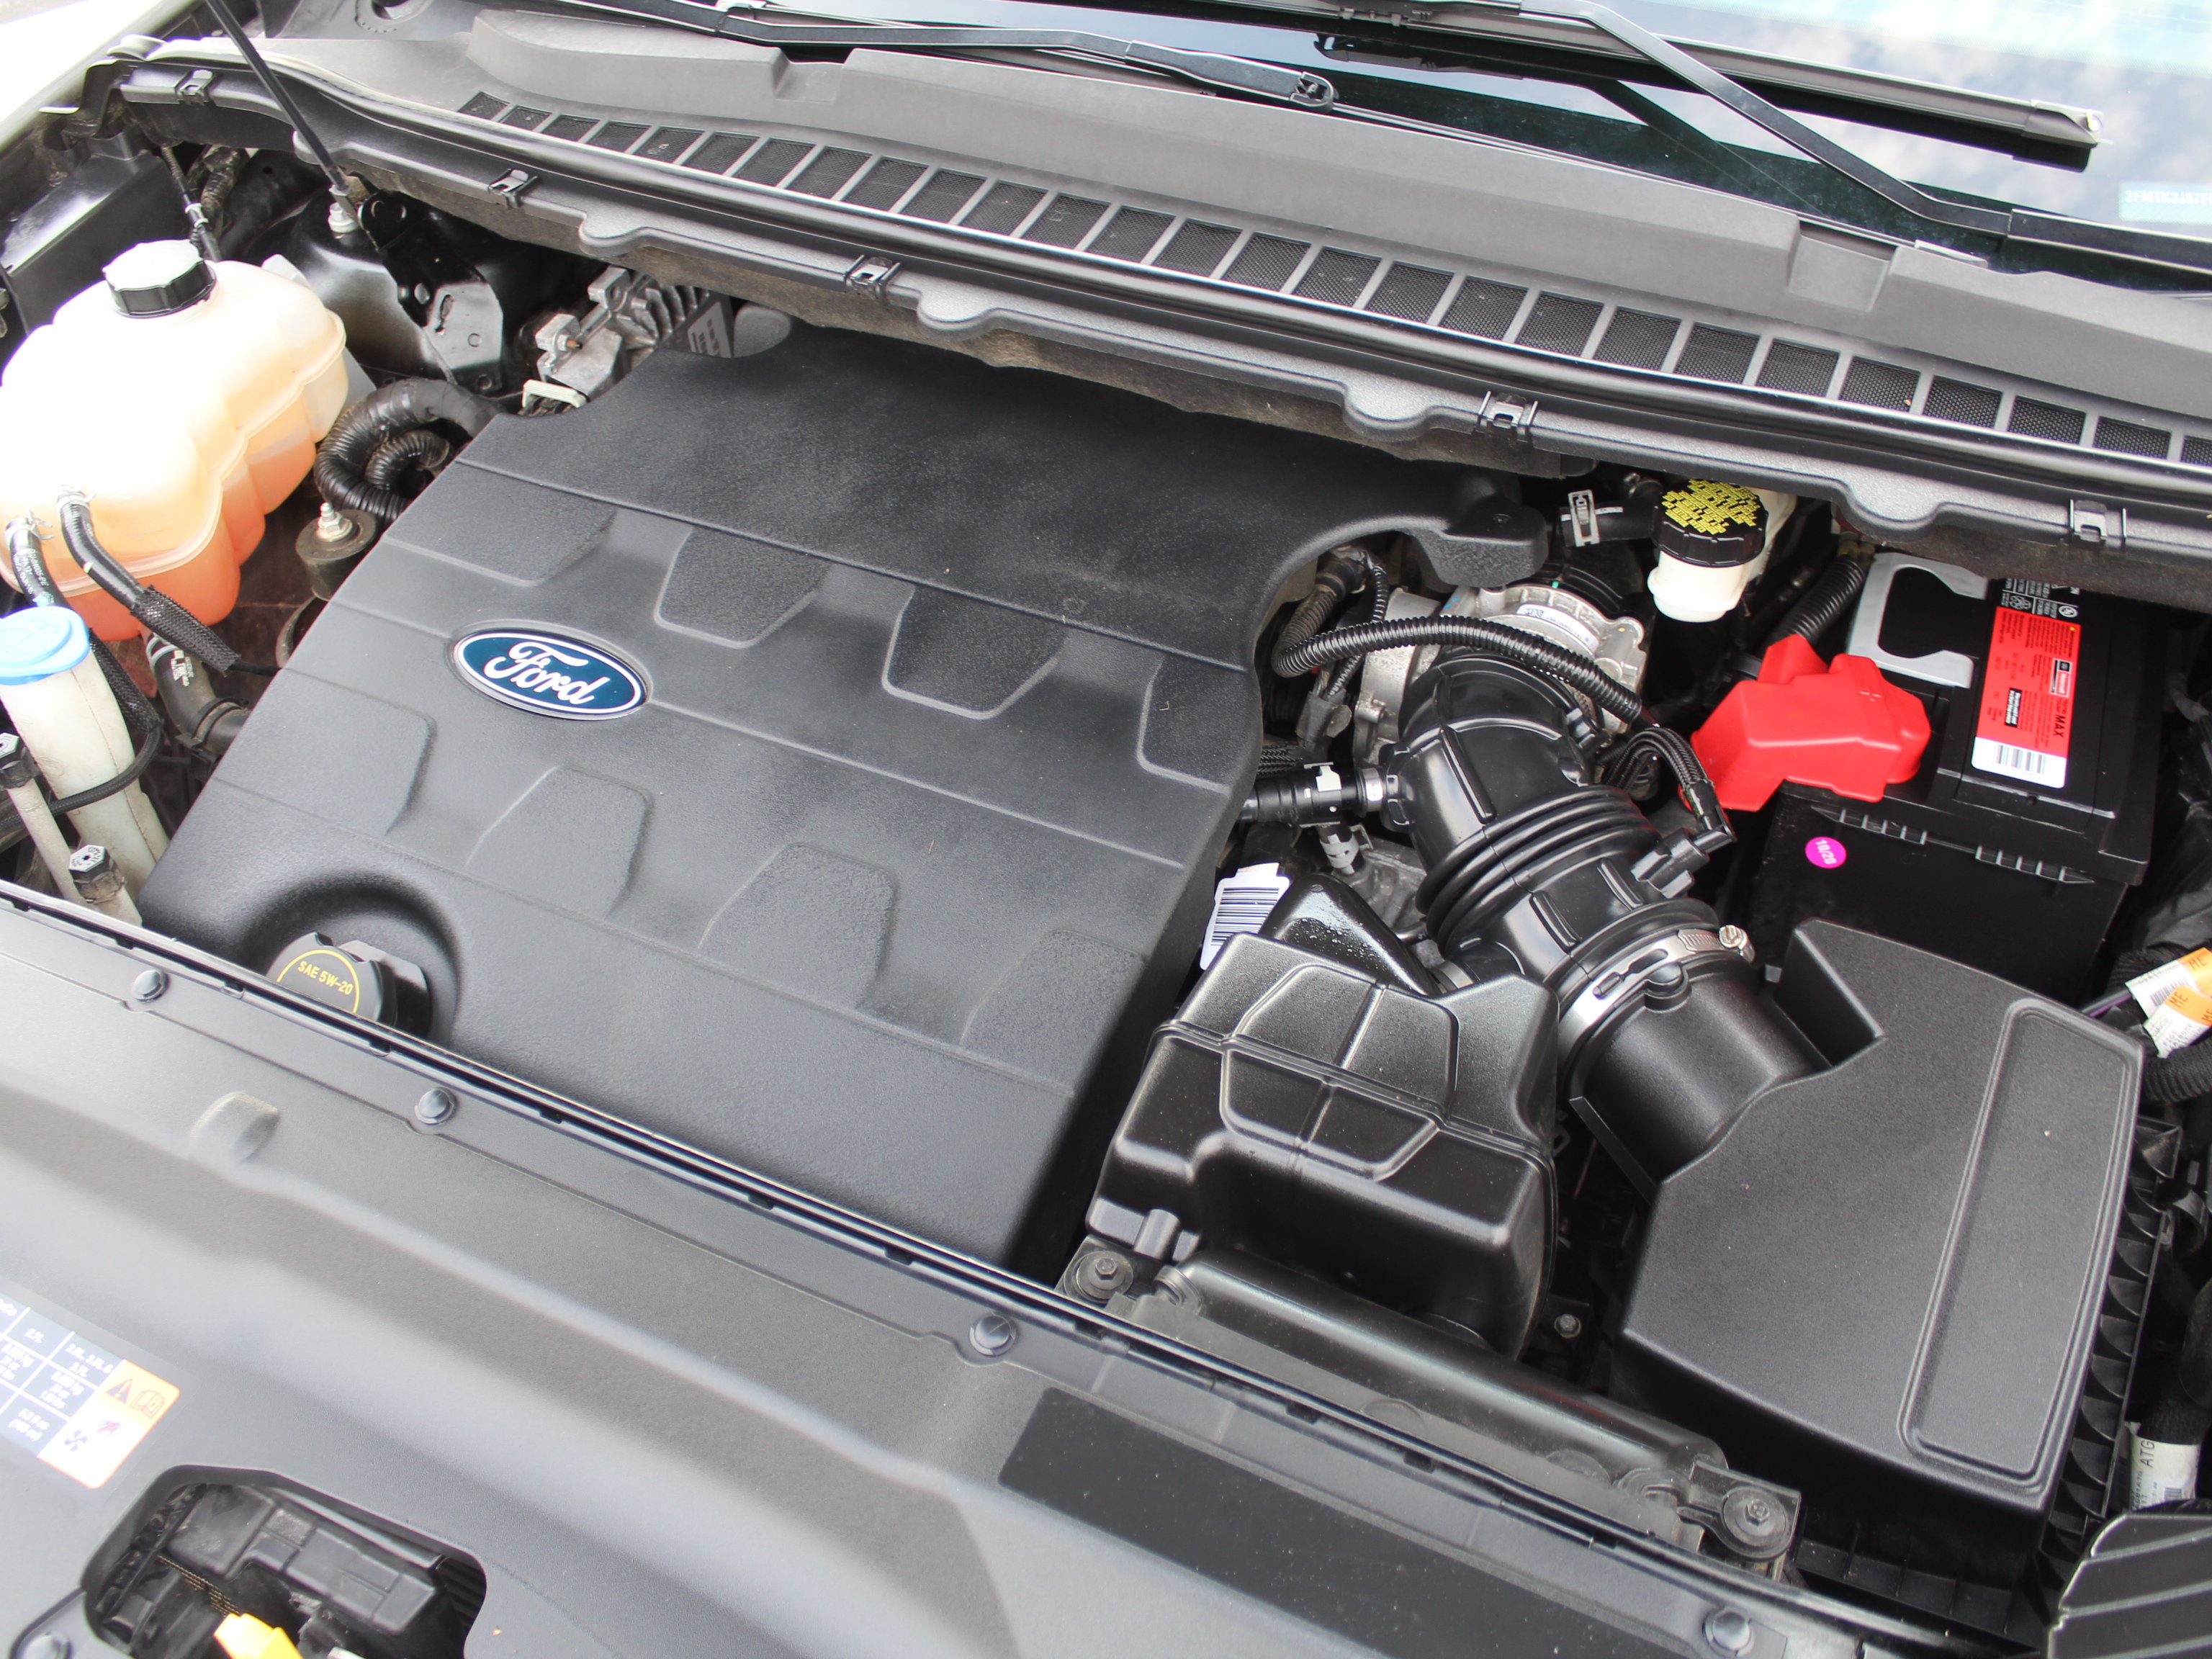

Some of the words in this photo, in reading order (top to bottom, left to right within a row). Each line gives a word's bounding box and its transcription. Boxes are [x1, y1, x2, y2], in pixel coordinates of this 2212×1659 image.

[483, 641, 611, 705] Ford
[2053, 714, 2067, 737] MAX
[1815, 839, 1837, 864] 10/20
[297, 961, 320, 979] SAE
[319, 971, 354, 995] 5W-20
[2169, 992, 2189, 1008] ME
[2140, 1440, 2155, 1468] ATG
